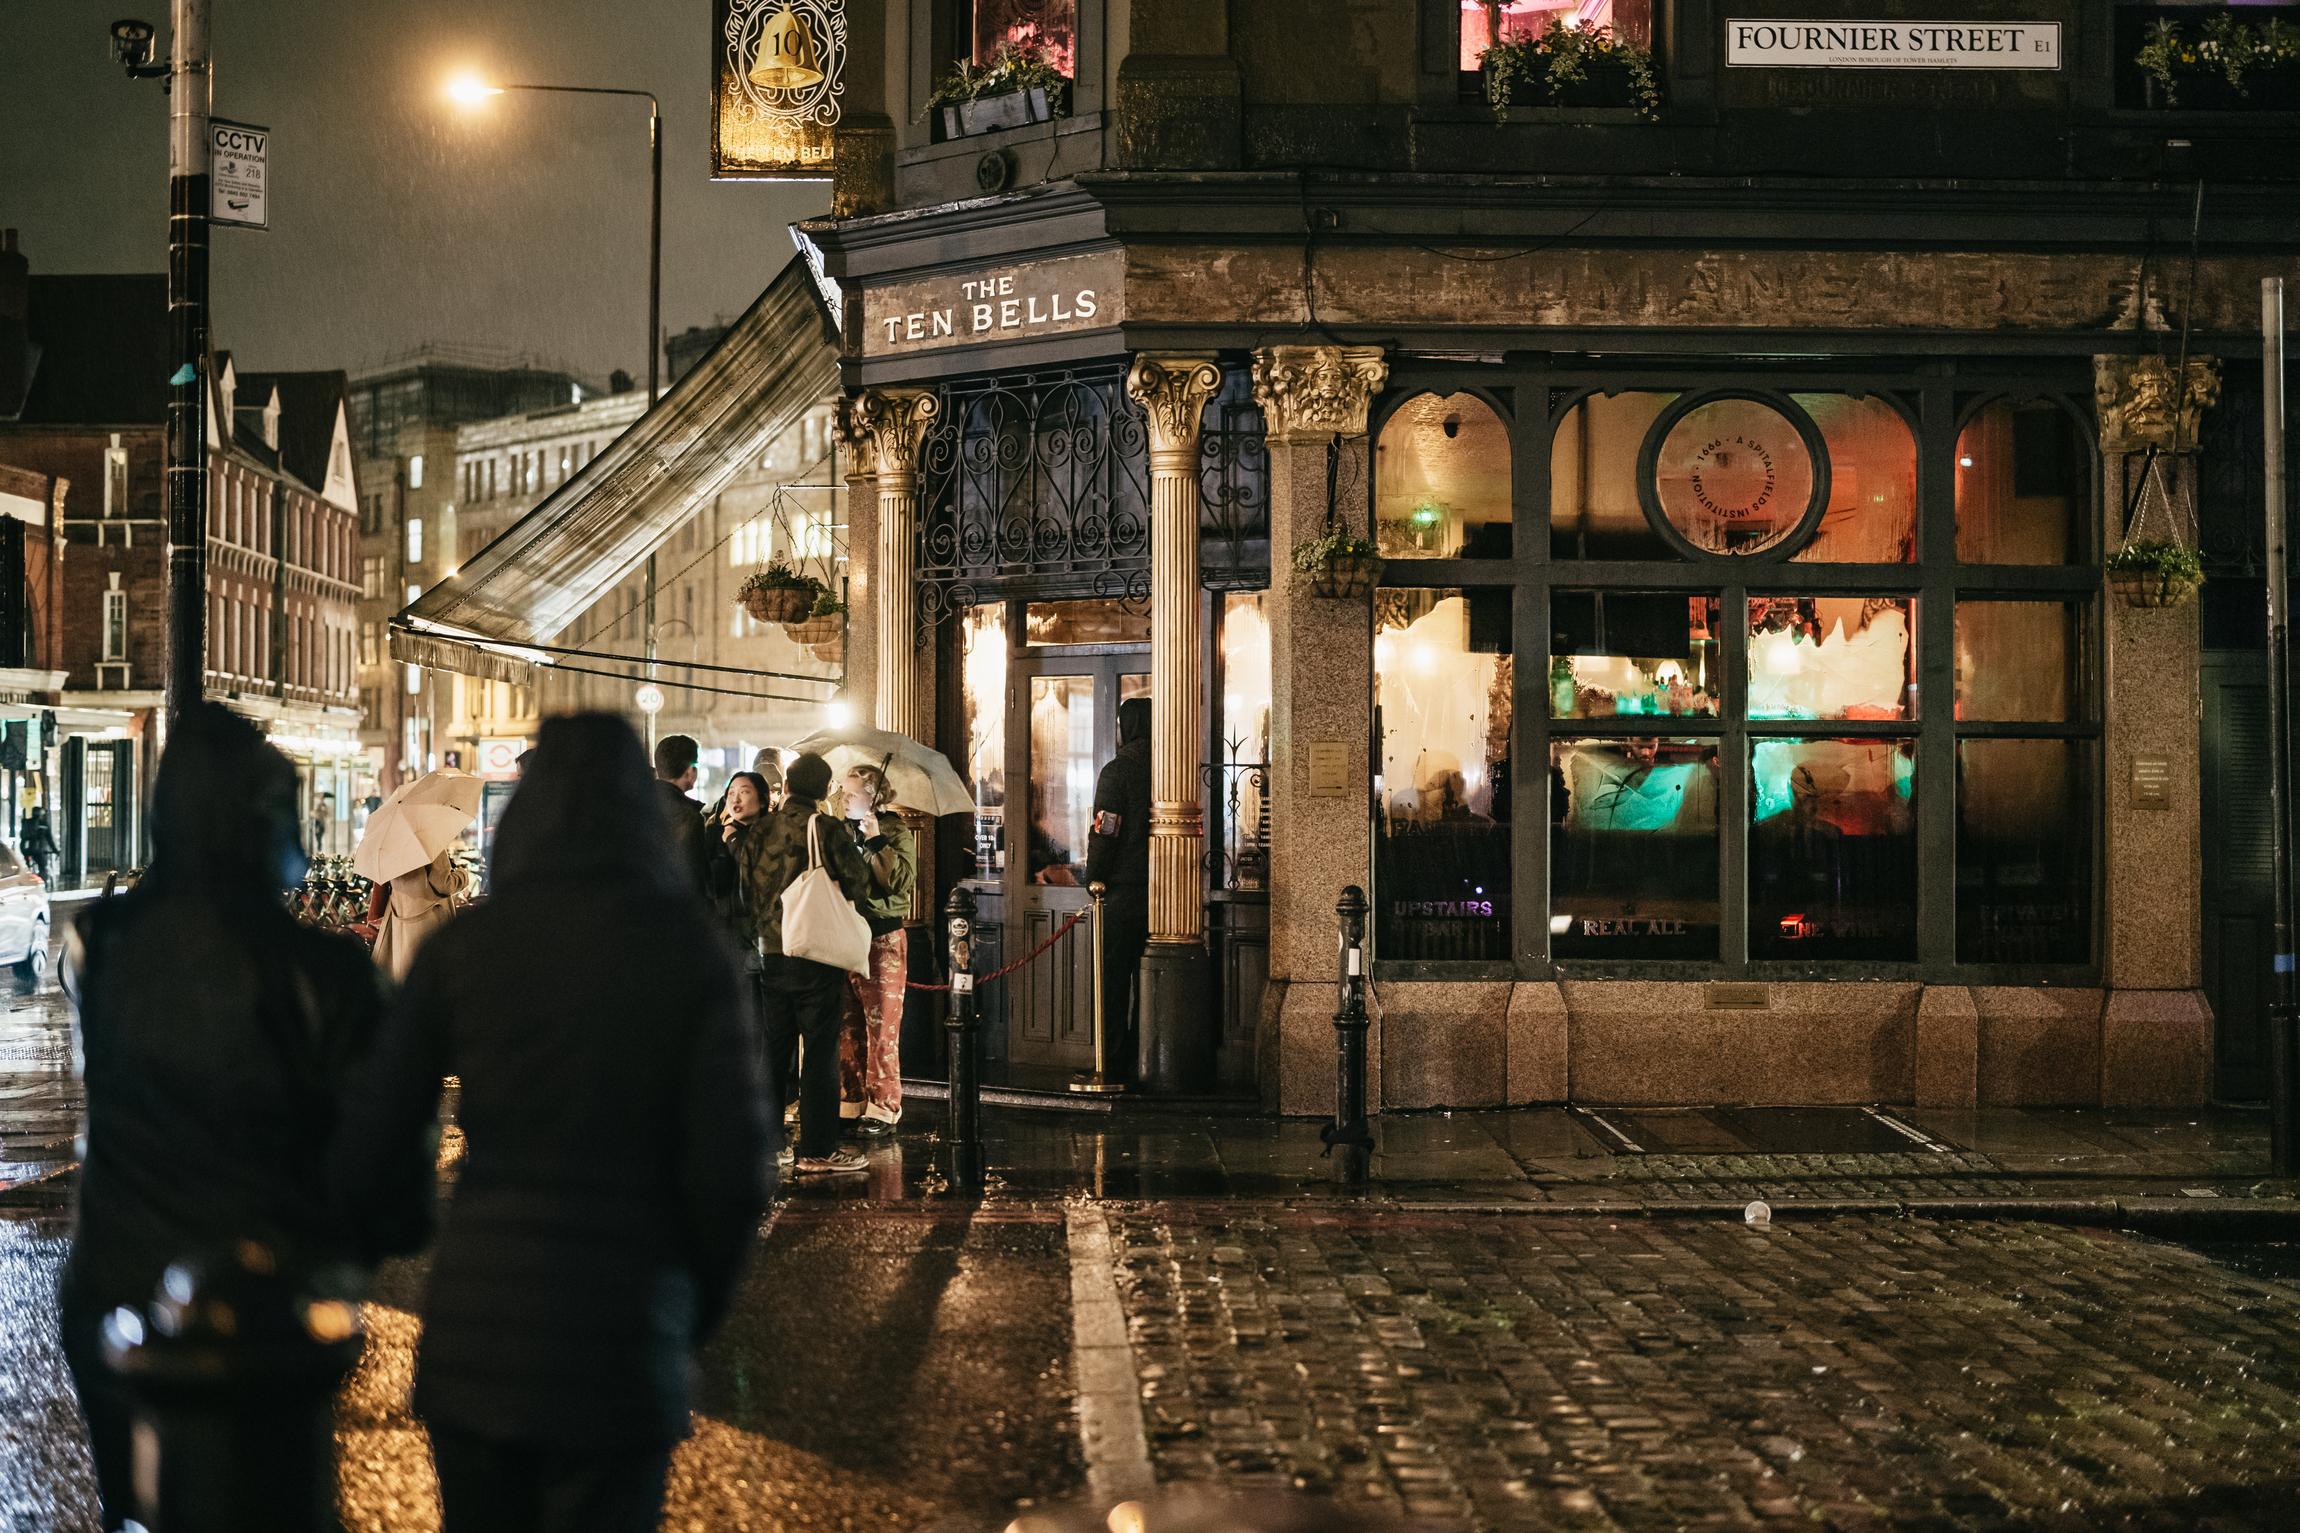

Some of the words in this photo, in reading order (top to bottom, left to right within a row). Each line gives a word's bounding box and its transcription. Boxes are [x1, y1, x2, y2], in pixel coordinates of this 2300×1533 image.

[772, 29, 802, 57] 10
[1736, 26, 1901, 51] FOURNIER
[1908, 27, 2025, 53] STREET
[2034, 40, 2051, 53] E1
[1828, 56, 1857, 64] LONDON
[1903, 57, 1926, 65] TOWER
[1927, 57, 1958, 65] HAMLETS
[216, 130, 264, 153] CCTV
[215, 149, 222, 157] IN
[224, 150, 264, 163] OPERATION
[246, 168, 261, 180] 218
[962, 276, 1014, 300] THE
[883, 309, 953, 344] TEN
[972, 289, 1098, 332] BELLS
[1697, 439, 1722, 461] 1666
[1736, 436, 1743, 444] A
[1747, 440, 1775, 511] SPITALFIELDS
[1692, 475, 1750, 518] INSTITUTION
[1394, 900, 1493, 917] UPSTAIRS
[1583, 919, 1640, 936] REAL
[1647, 919, 1687, 936] ALE
